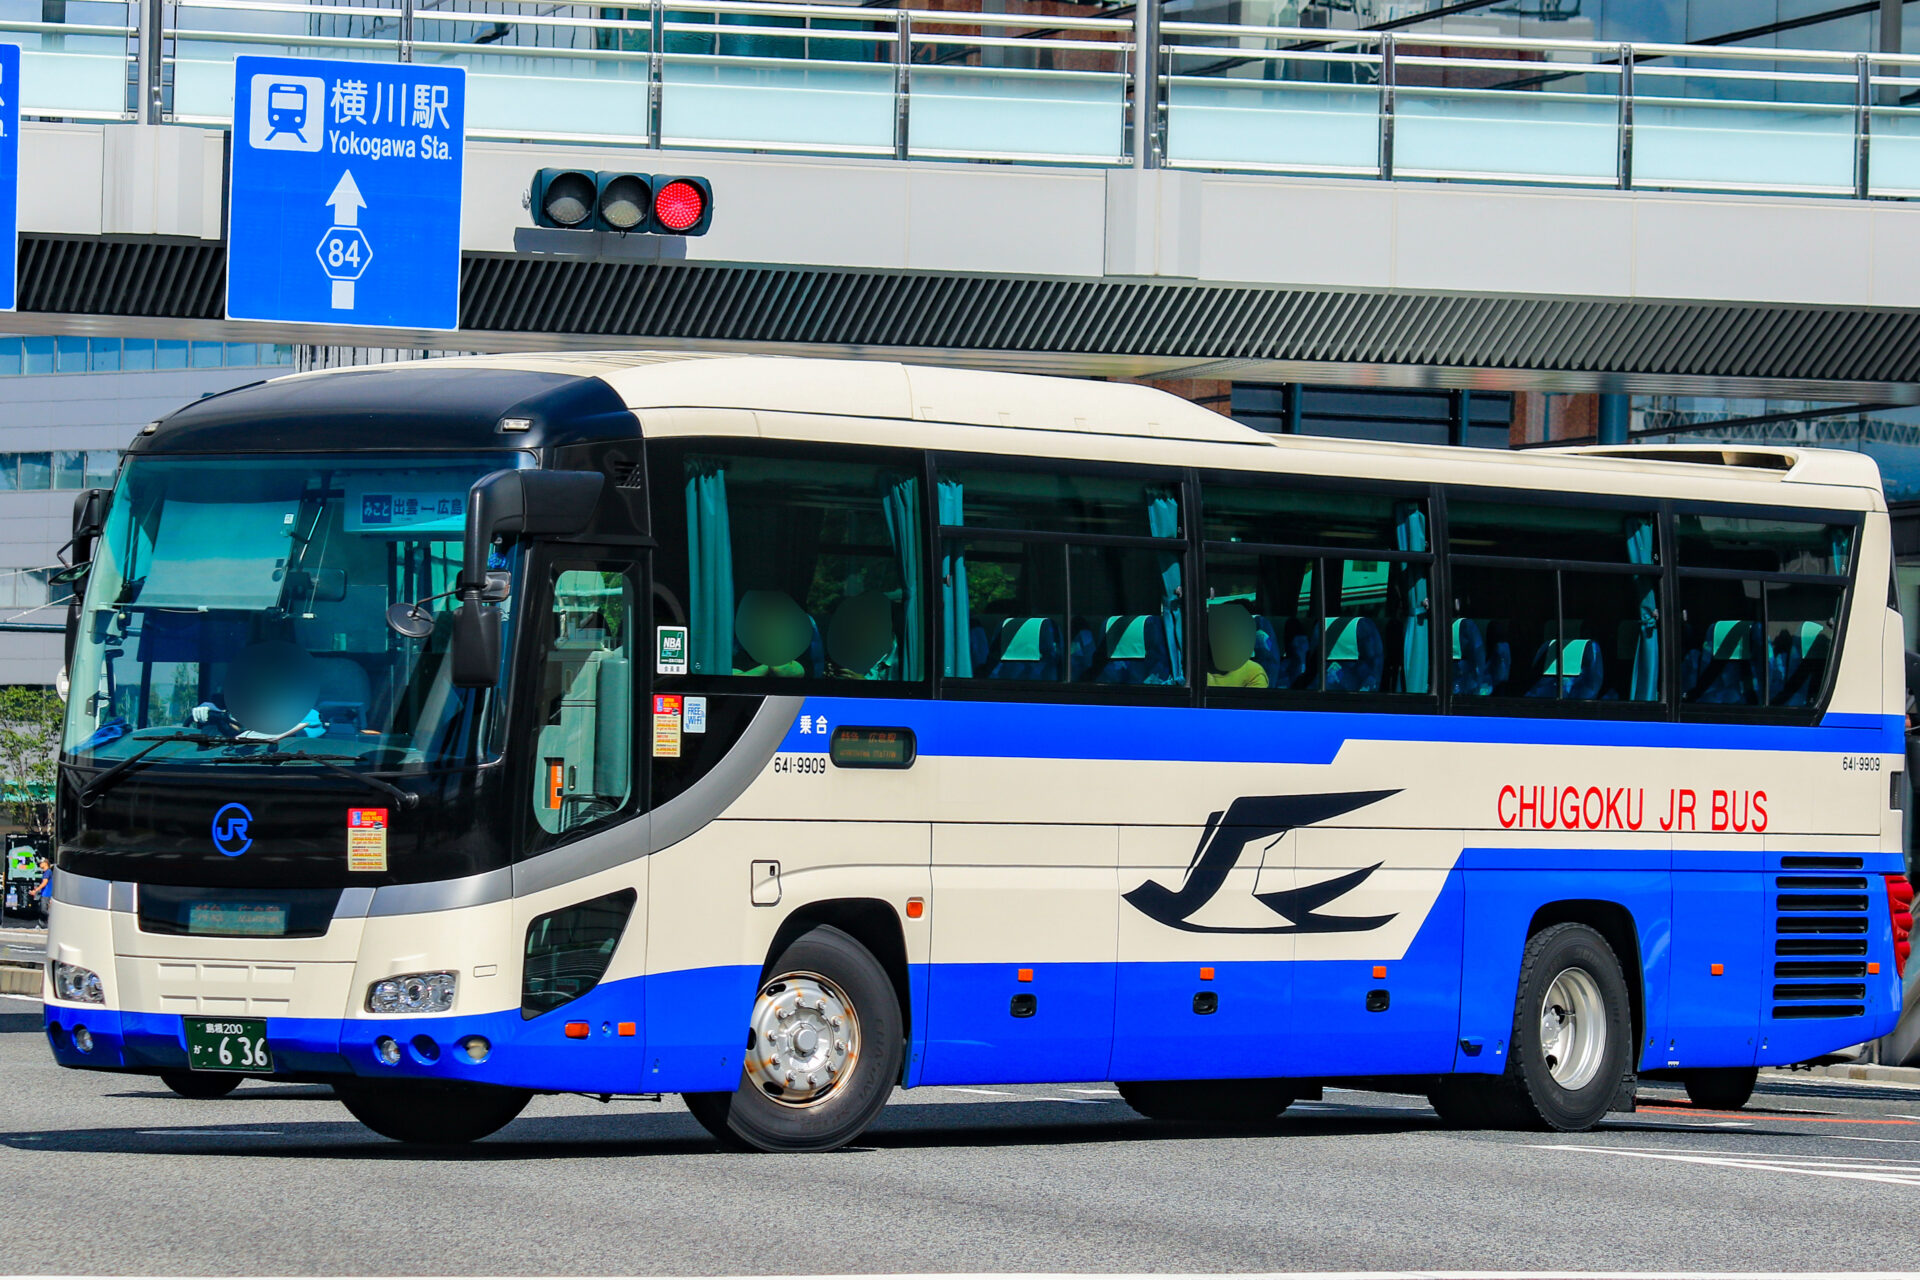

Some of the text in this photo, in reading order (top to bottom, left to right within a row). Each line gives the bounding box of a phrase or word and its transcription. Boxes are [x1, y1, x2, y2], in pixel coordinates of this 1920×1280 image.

[331, 79, 450, 129] 横川駅
[329, 130, 453, 161] Yokogawa Sta.
[328, 238, 361, 268] 84
[393, 498, 418, 516] 出雲
[437, 498, 463, 516] 広島
[663, 637, 682, 650] NBA
[800, 715, 828, 734] 乗合
[774, 756, 826, 774] 641-9909
[1842, 756, 1880, 771] 641-9909
[1498, 785, 1768, 832] CHUGOKU JR BUS
